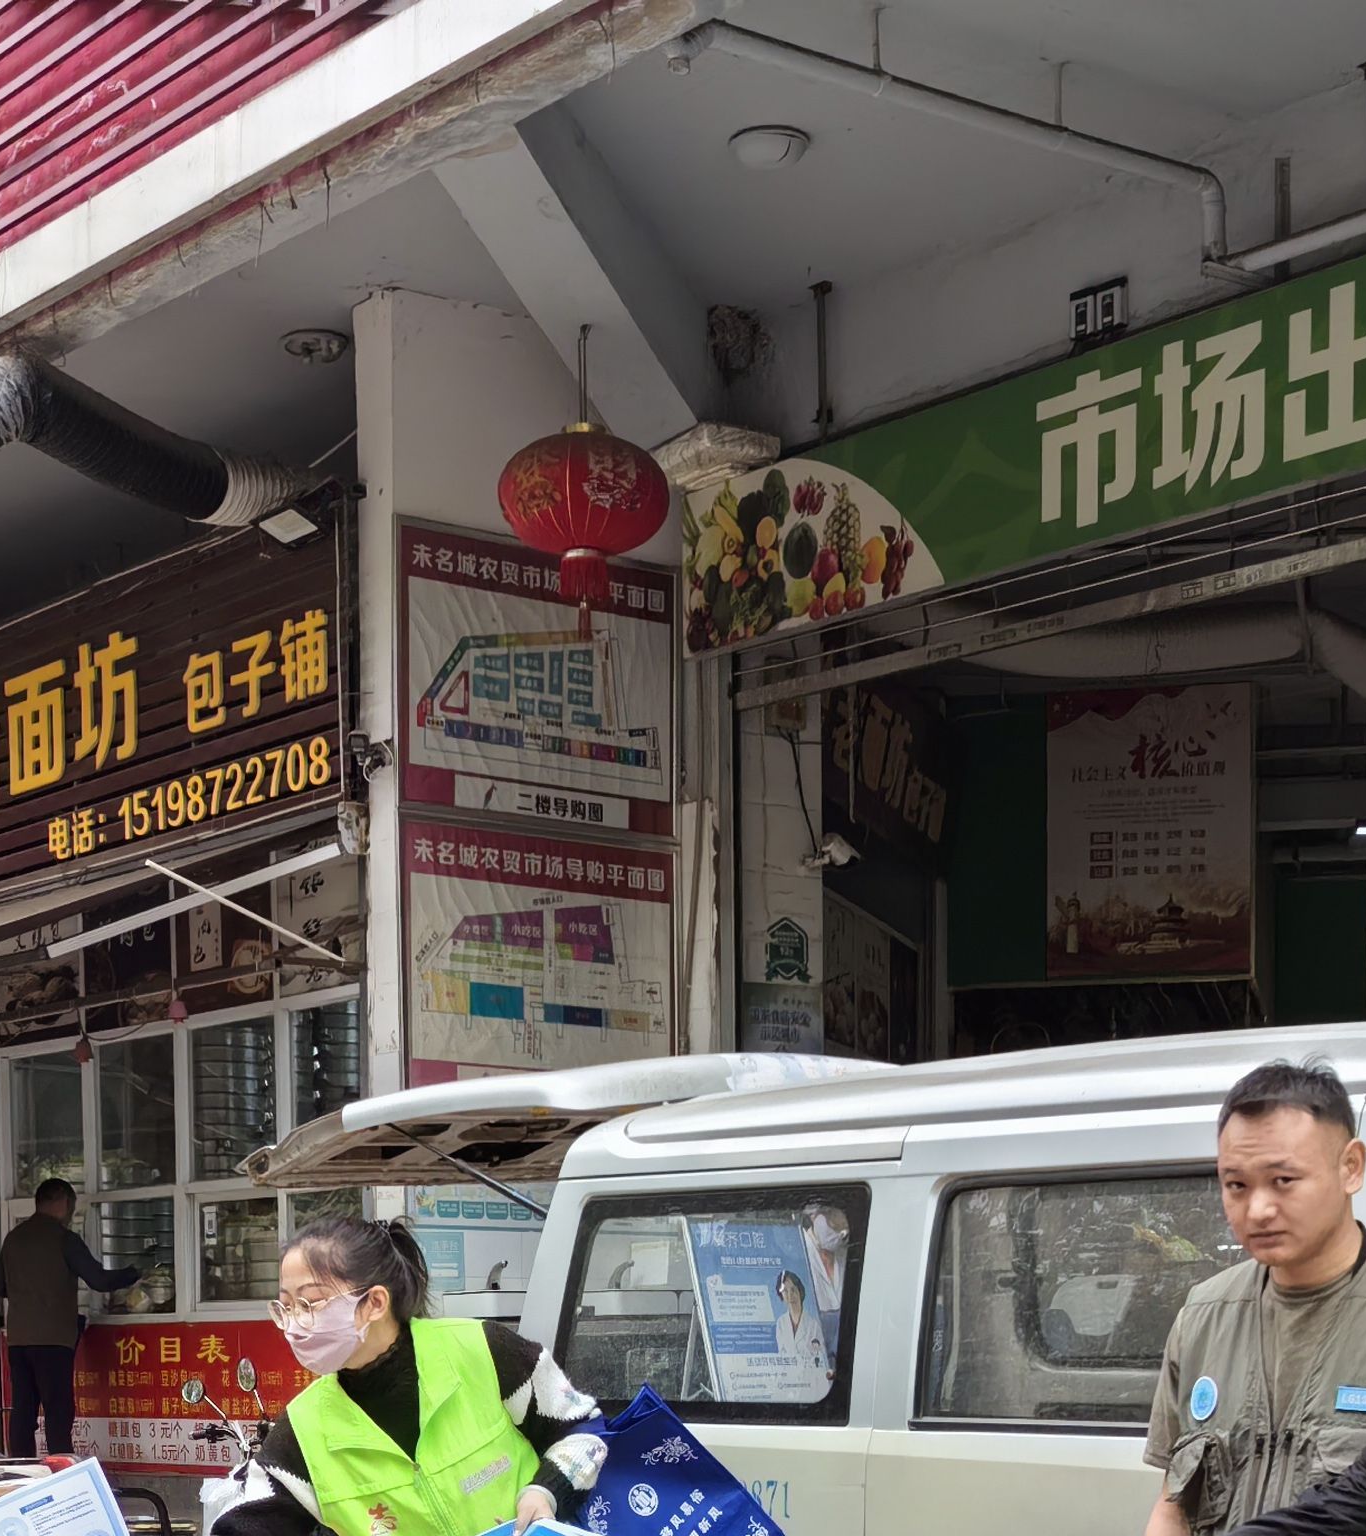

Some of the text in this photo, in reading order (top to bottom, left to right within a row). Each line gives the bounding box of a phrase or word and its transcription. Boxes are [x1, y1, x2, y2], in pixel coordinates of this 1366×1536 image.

[412, 543, 665, 612] 未名城农贸市场平面图
[186, 609, 329, 734] 包子铺
[414, 838, 665, 893] 未名城农贸市场导购平面图
[116, 1334, 230, 1366] 价目表
[741, 1480, 790, 1519] 871
